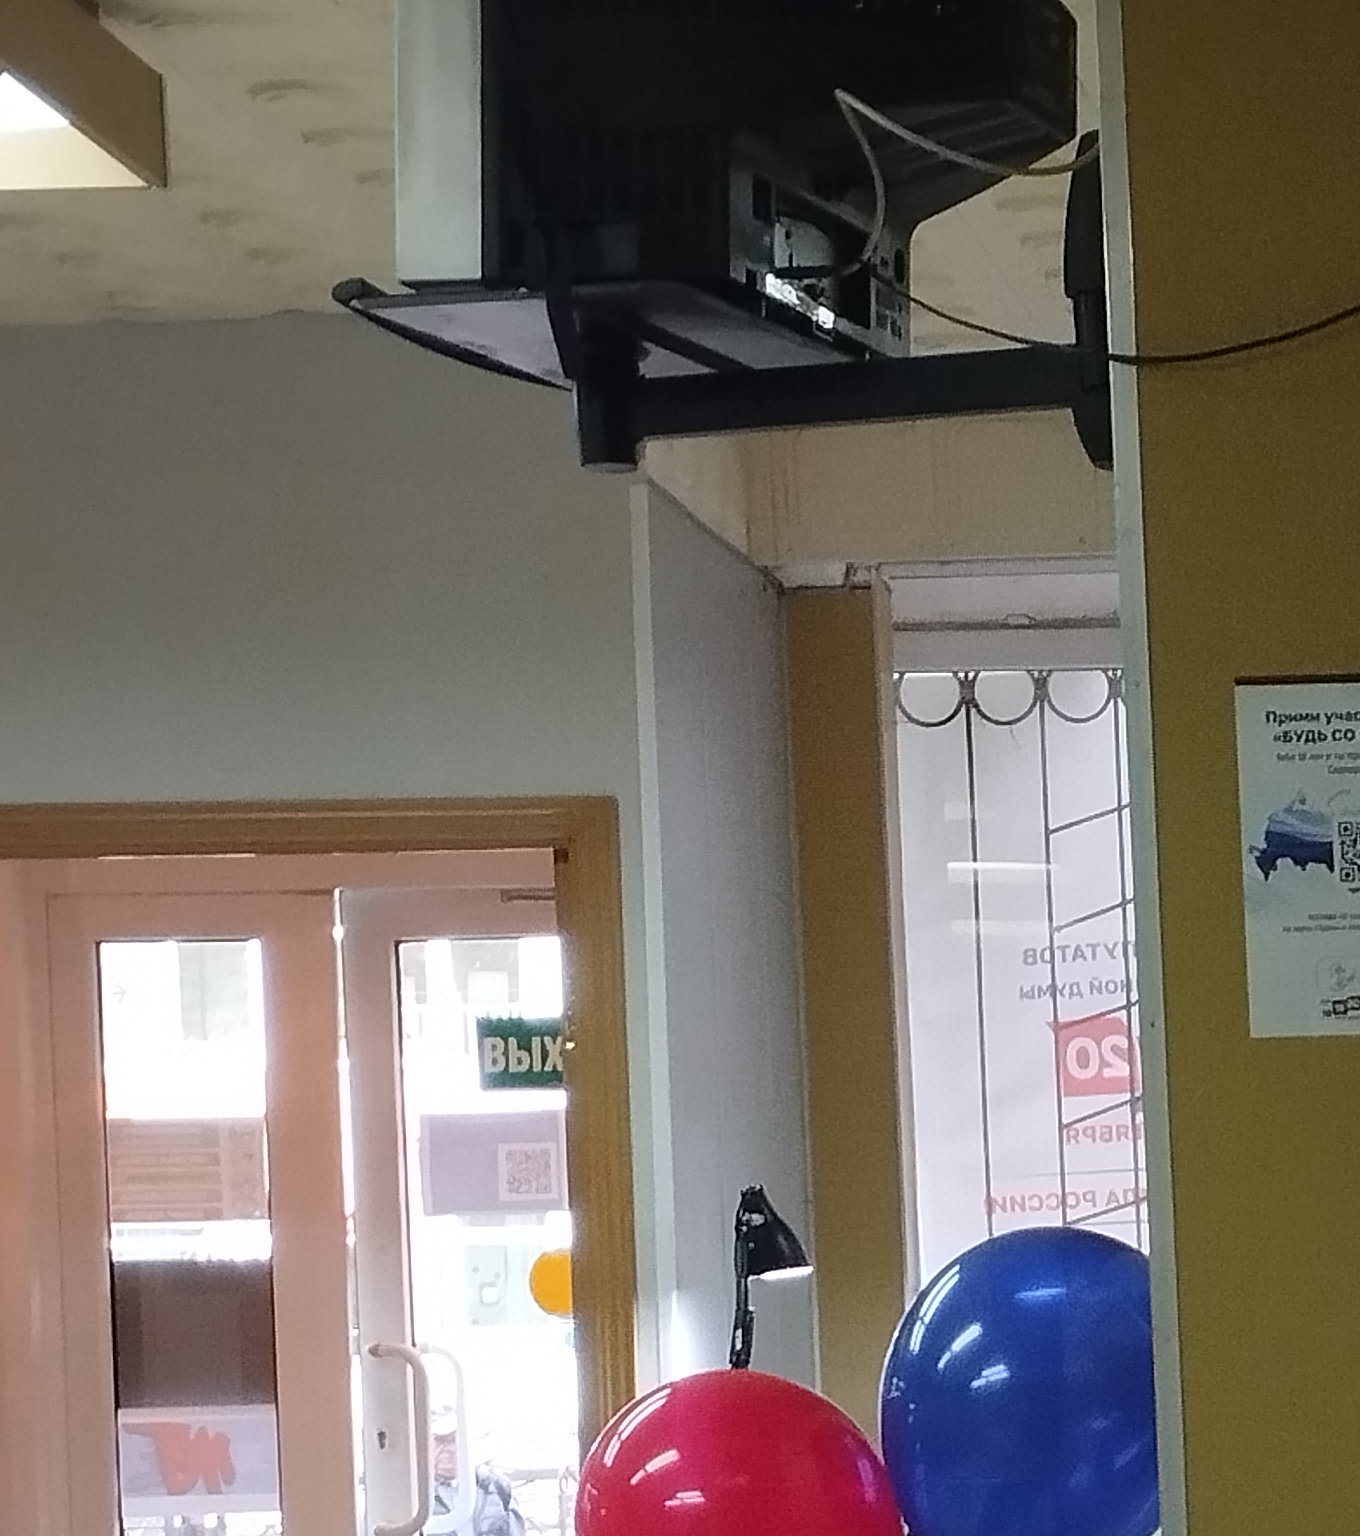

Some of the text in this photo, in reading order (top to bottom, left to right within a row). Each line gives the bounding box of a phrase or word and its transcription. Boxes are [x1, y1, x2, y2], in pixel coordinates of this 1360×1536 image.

[1265, 710, 1320, 727] Прими
[1273, 728, 1328, 745] «БУДЬ
[1331, 728, 1356, 742] СО
